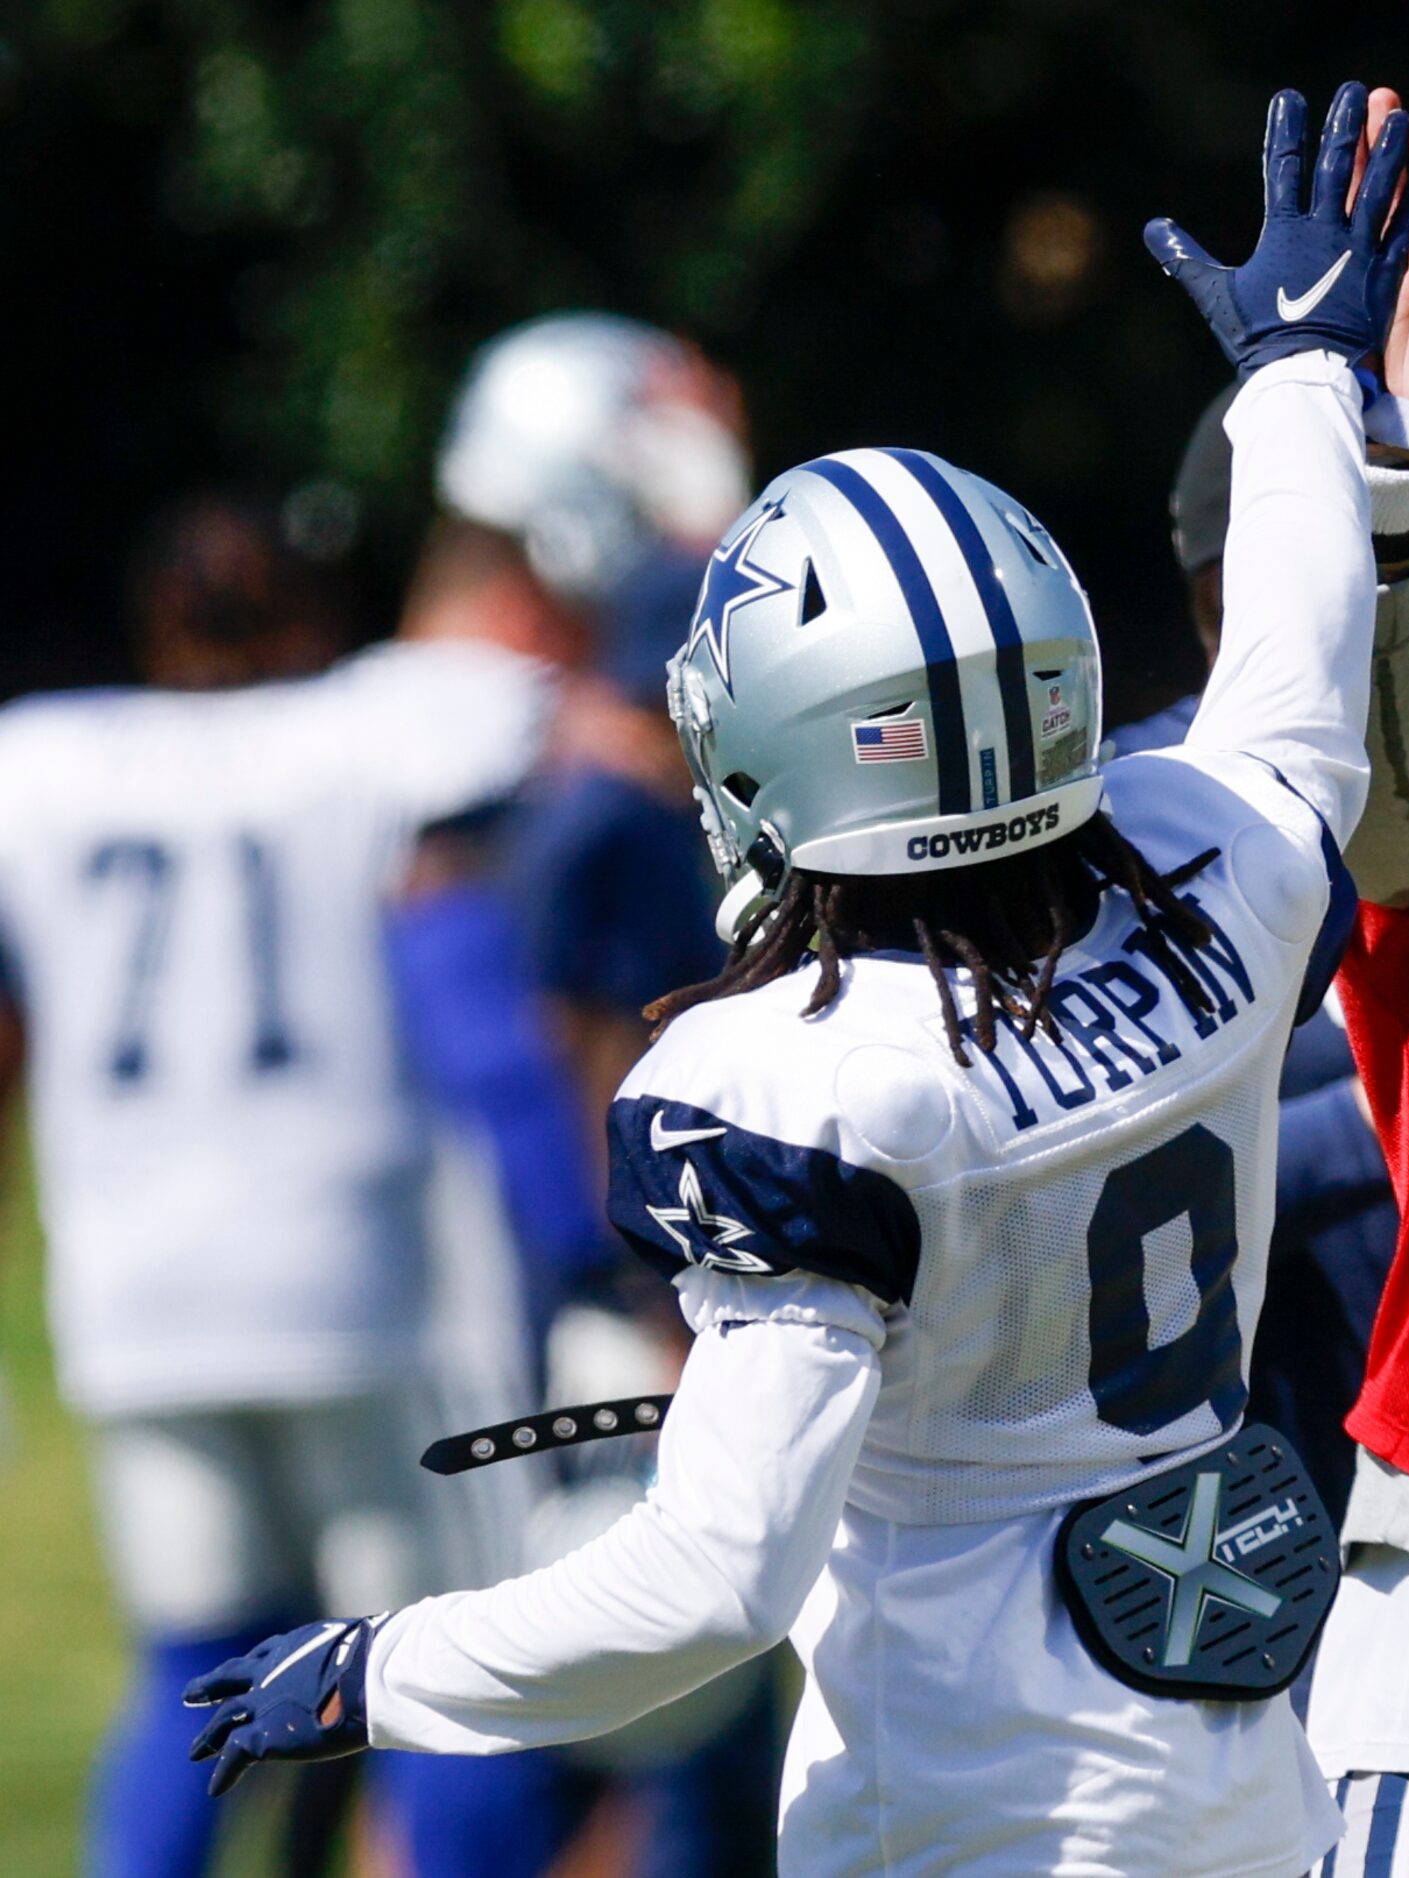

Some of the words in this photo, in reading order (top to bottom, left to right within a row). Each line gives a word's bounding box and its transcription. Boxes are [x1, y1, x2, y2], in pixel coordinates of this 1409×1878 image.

[85, 832, 300, 1088] 71
[907, 803, 1061, 861] COWBOYS
[1087, 1122, 1249, 1437] 0
